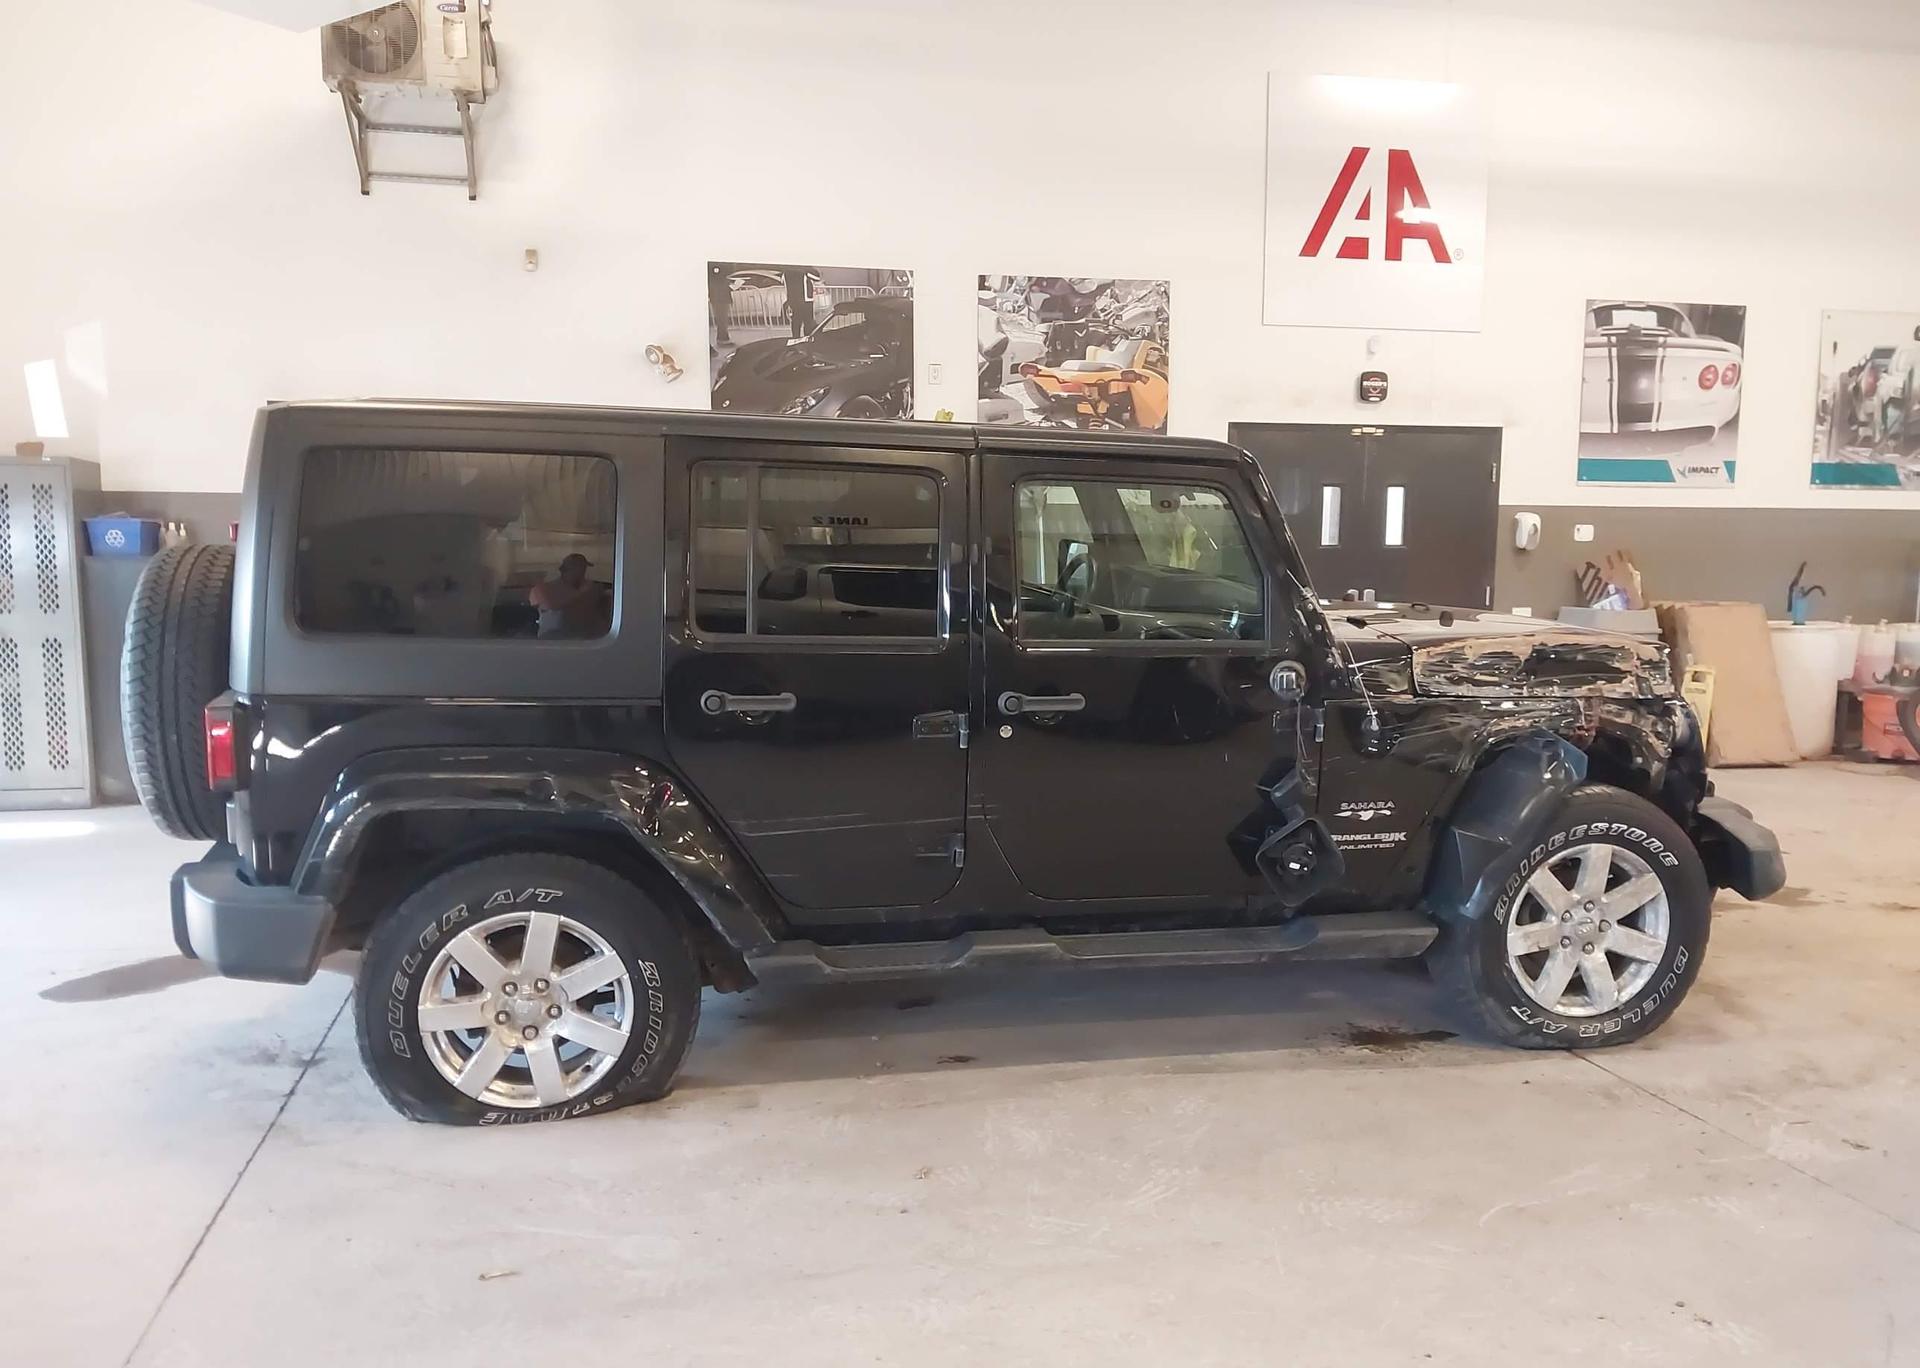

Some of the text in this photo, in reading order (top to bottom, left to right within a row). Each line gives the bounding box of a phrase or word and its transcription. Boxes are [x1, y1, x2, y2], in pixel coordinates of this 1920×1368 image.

[1687, 465, 1720, 474] IMPACT
[1340, 800, 1396, 810] SAHARA
[1494, 822, 1679, 925] BRIDGESTONE
[388, 888, 564, 1058] DUELER A/T
[1510, 945, 1690, 1038] DUELER A/T
[479, 959, 664, 1126] BRIDGSTONE
